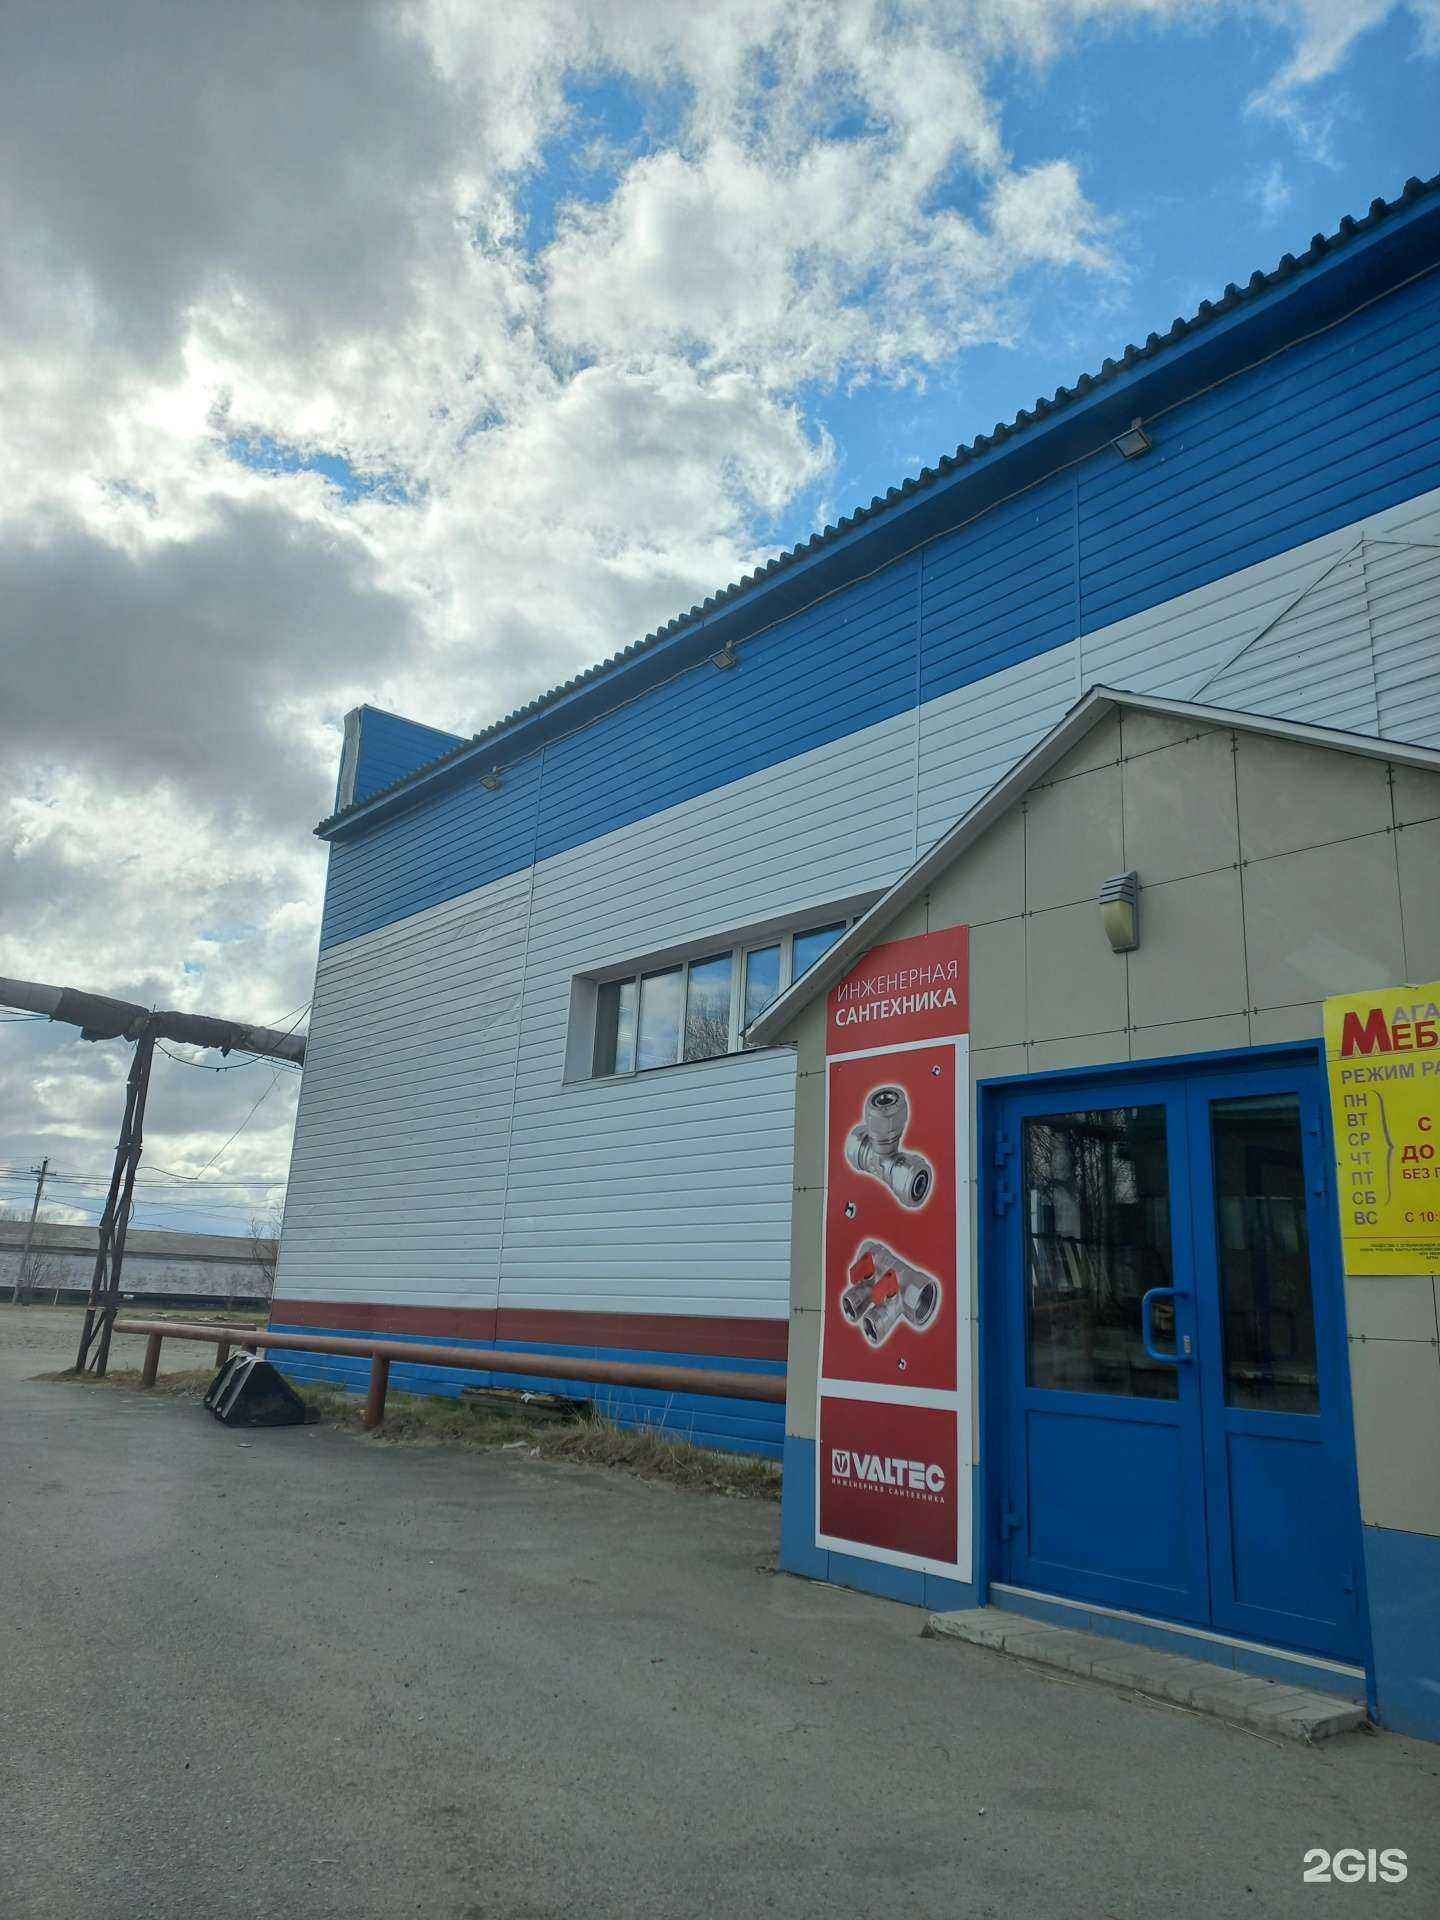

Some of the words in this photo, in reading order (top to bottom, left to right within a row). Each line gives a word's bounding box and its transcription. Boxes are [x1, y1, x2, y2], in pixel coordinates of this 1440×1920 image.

[836, 960, 958, 1002] ИНЖЕНЕРНАЯ
[835, 987, 958, 1026] САНТЕХНИКА
[1341, 1062, 1415, 1085] РЕЖИМ
[1344, 1093, 1367, 1108] ПН
[1347, 1112, 1367, 1127] ВТ
[1417, 1116, 1432, 1132] С
[1348, 1132, 1370, 1146] СР
[1350, 1151, 1371, 1165] ЧТ
[1401, 1144, 1435, 1164] ДО
[1352, 1171, 1373, 1185] ПТ
[1402, 1167, 1430, 1180] БЕЗ
[1352, 1191, 1376, 1205] СБ
[1354, 1211, 1378, 1225] ВС
[1405, 1211, 1415, 1223] С
[852, 1452, 945, 1492] VALTEC
